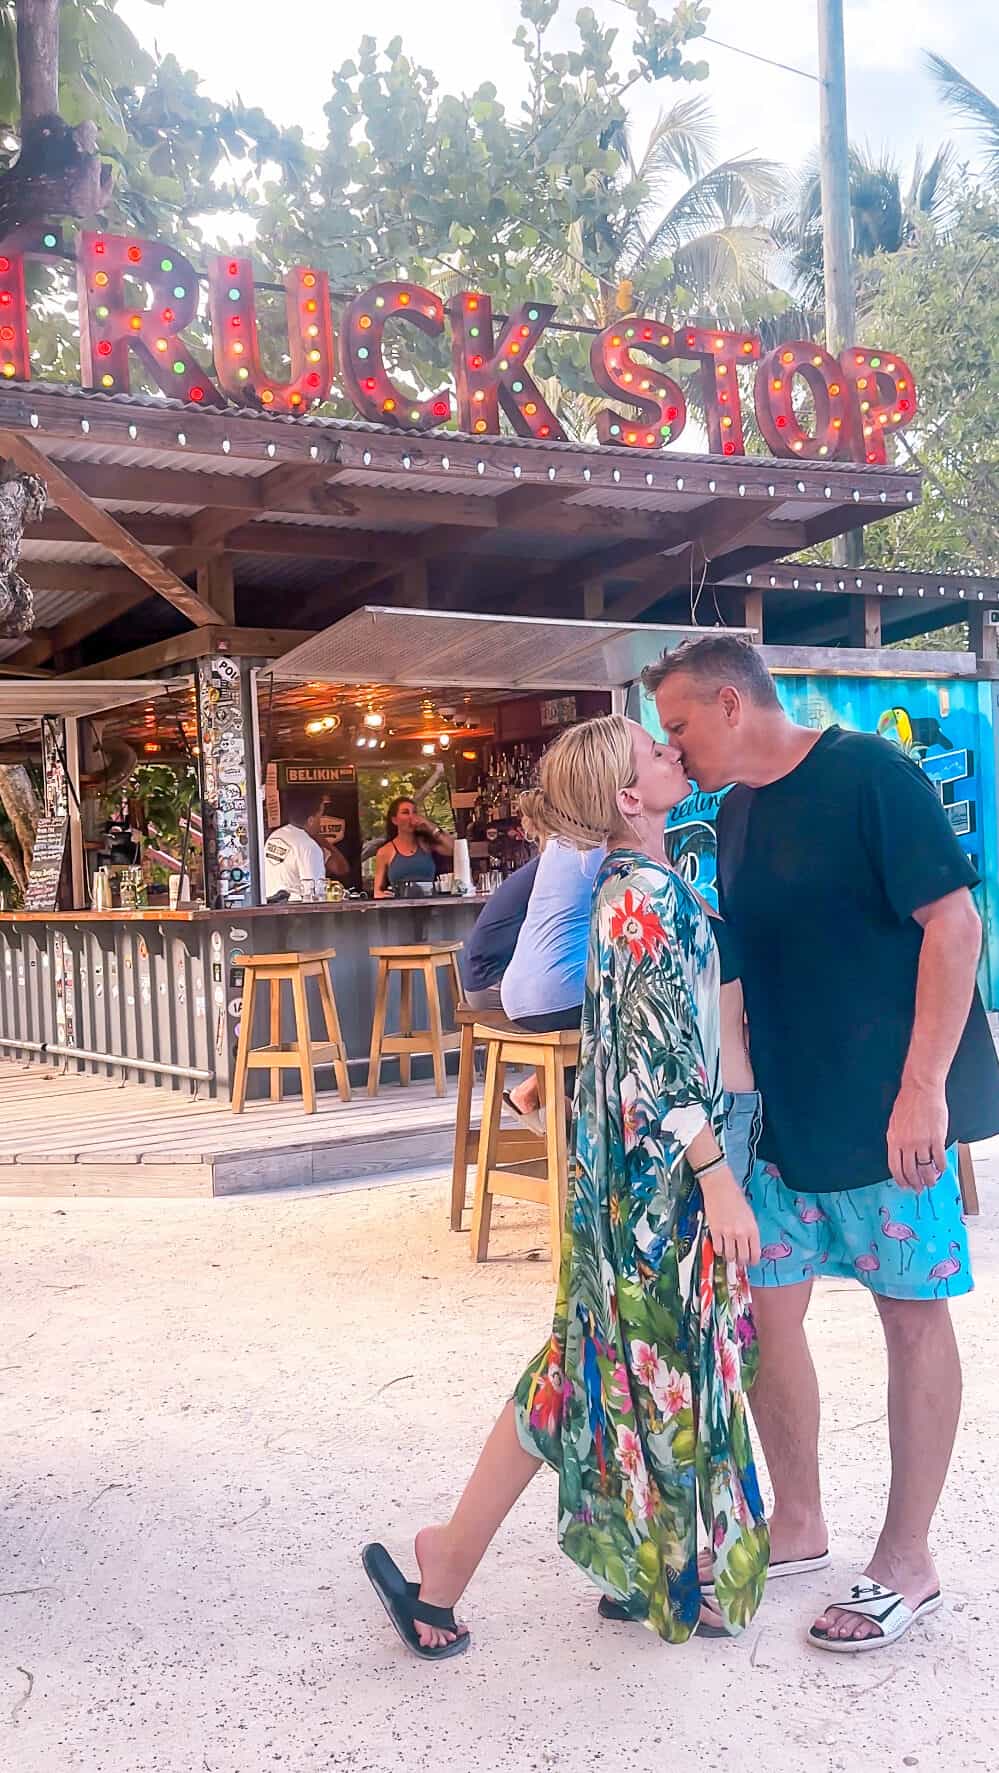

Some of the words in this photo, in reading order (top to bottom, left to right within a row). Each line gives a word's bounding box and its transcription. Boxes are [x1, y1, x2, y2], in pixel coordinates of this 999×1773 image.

[0, 222, 567, 441] TRUCK
[590, 317, 918, 465] STOP
[289, 769, 339, 781] BELIKIN
